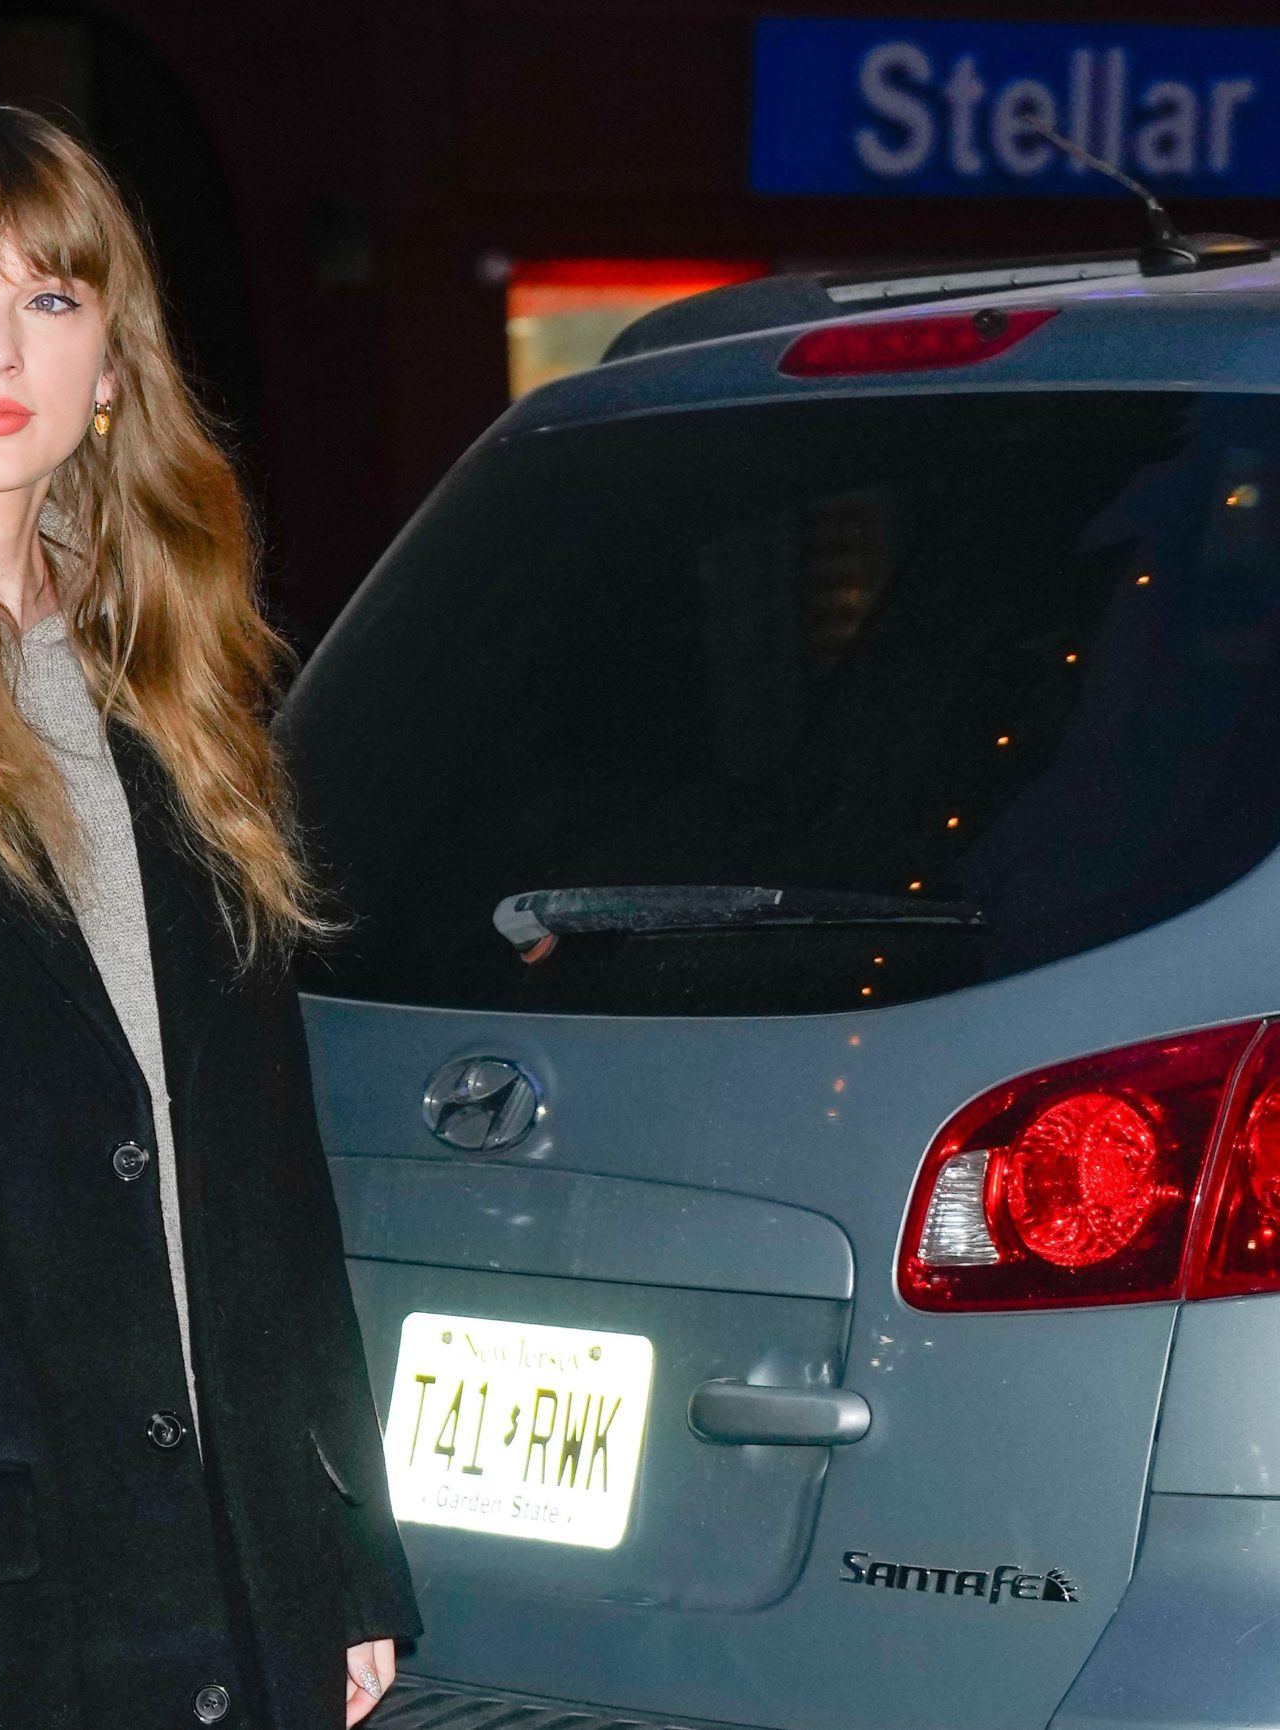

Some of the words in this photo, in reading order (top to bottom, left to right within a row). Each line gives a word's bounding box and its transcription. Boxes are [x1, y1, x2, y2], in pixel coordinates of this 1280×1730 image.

[853, 40, 1256, 176] Stellar
[406, 1373, 489, 1476] T41
[523, 1387, 622, 1493] RWK
[436, 1484, 502, 1515] Garden
[510, 1495, 561, 1524] State
